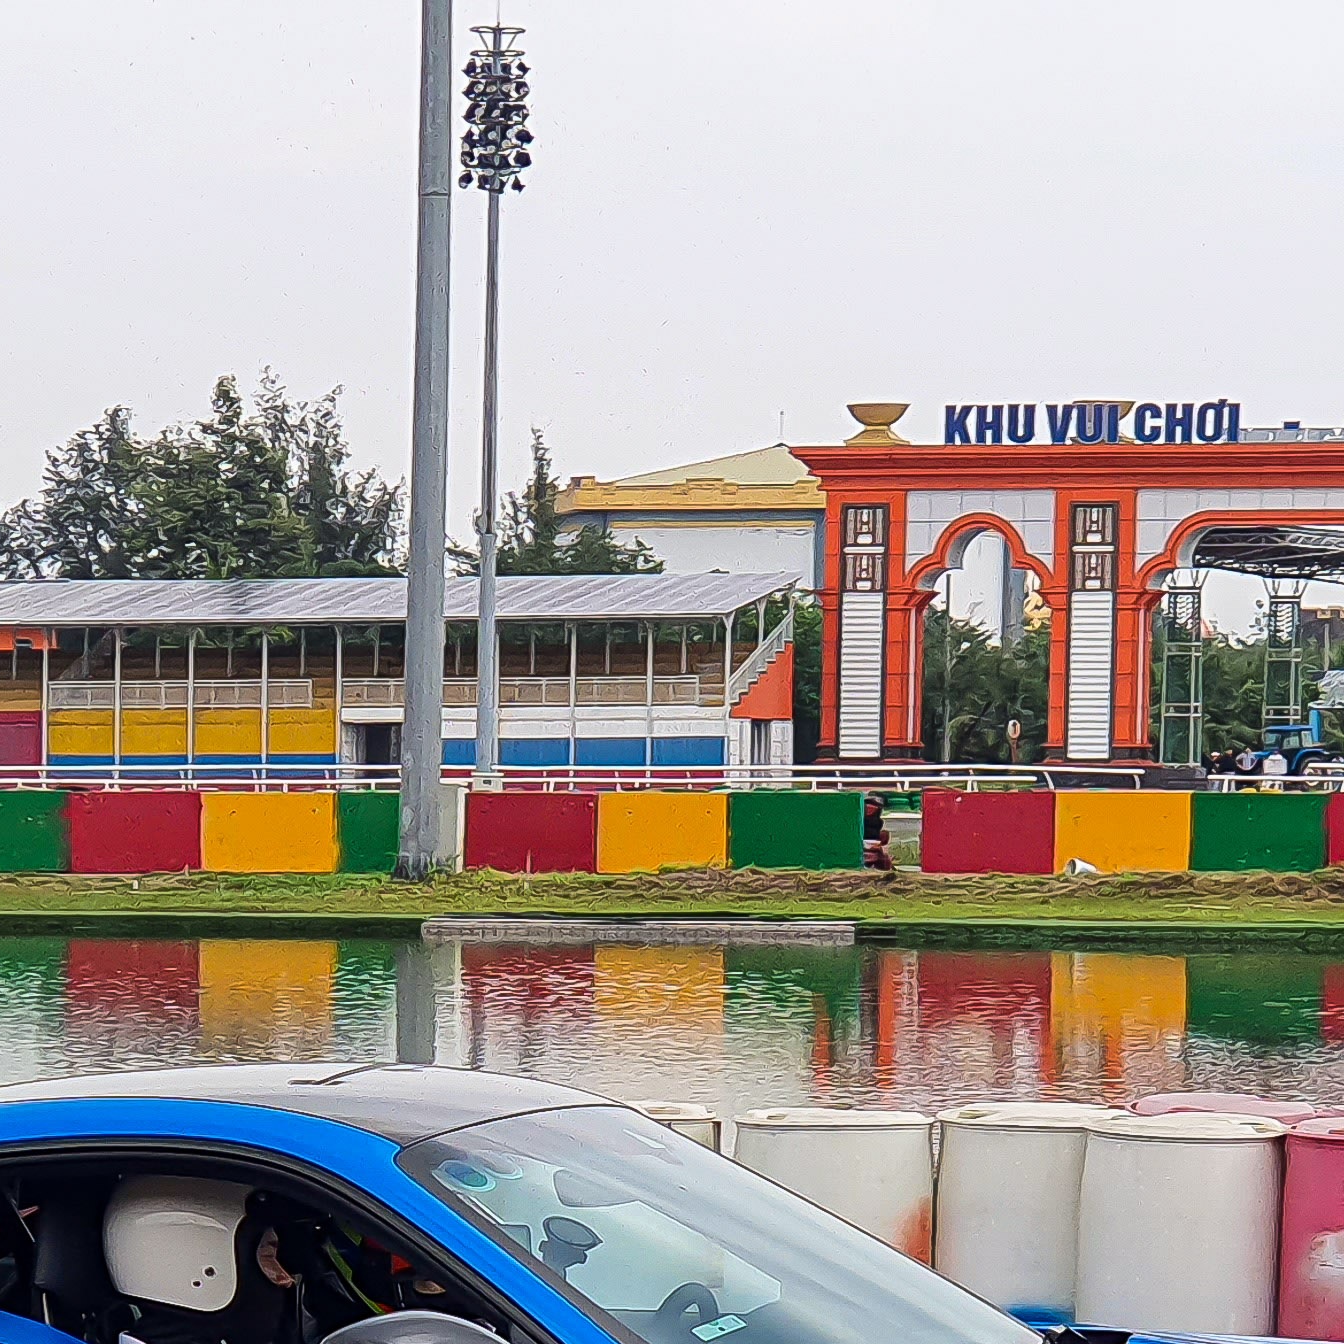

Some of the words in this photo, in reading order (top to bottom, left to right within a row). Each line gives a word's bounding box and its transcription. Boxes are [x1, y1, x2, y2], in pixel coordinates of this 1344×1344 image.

[944, 403, 1036, 445] KHU
[1046, 403, 1120, 444] VUI
[1133, 399, 1243, 444] CHƠI
